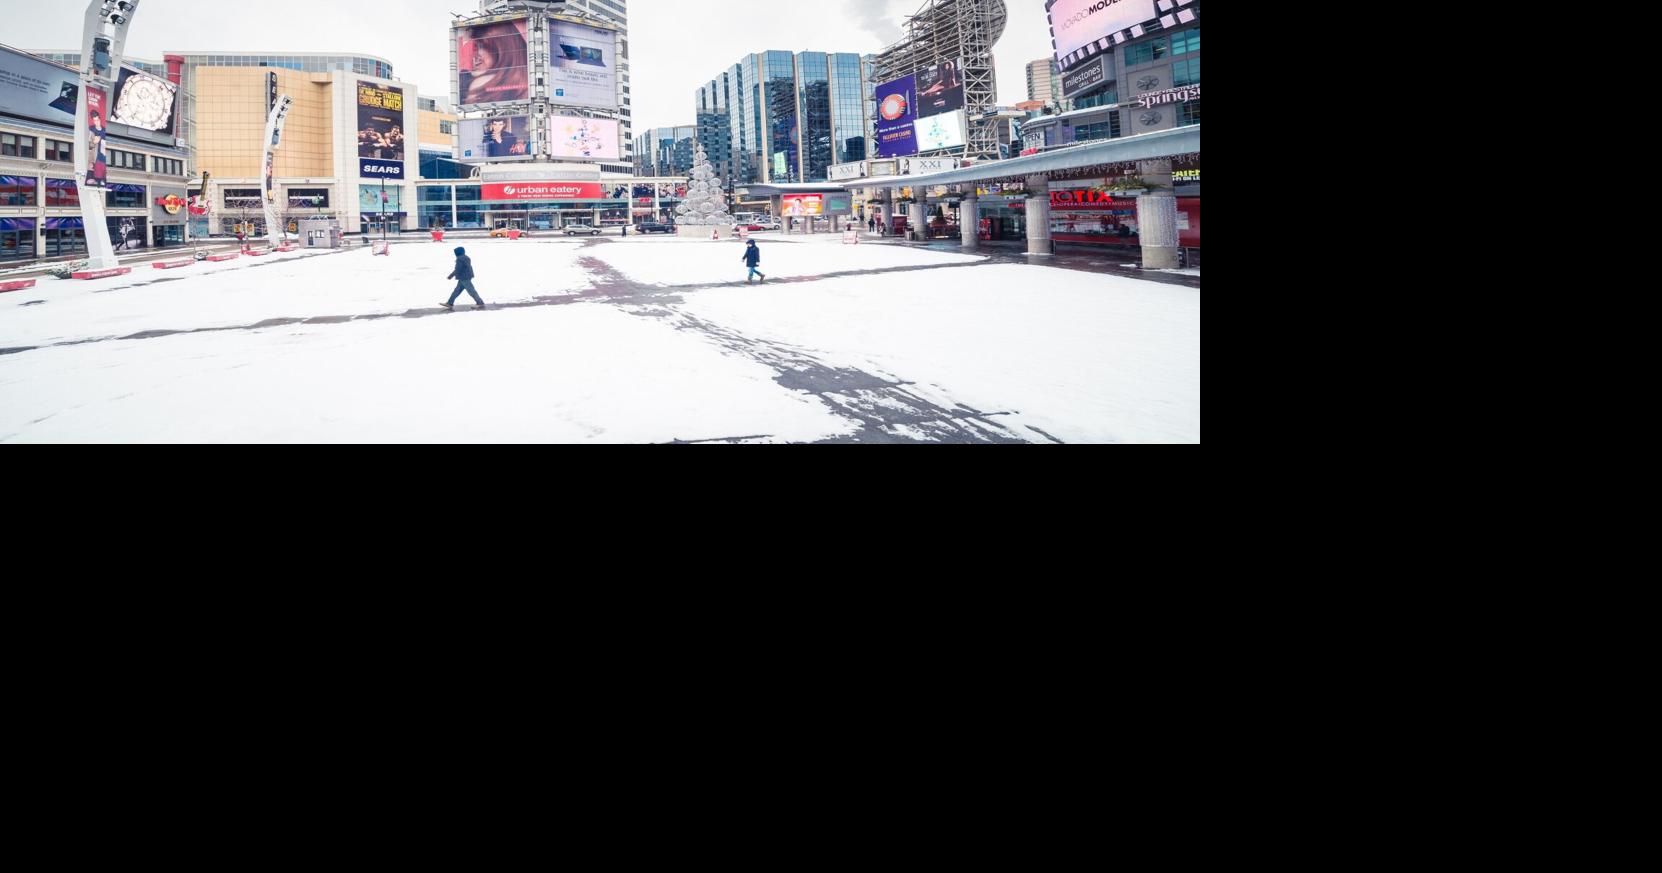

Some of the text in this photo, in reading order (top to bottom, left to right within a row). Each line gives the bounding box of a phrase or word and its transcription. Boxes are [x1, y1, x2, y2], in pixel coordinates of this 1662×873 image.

[1065, 64, 1101, 89] milestones
[1092, 74, 1102, 82] BAR
[383, 98, 402, 111] MATCH
[363, 164, 400, 175] SEARS
[840, 164, 854, 174] XXI
[919, 159, 941, 171] XXI
[517, 185, 582, 195] urban eatery
